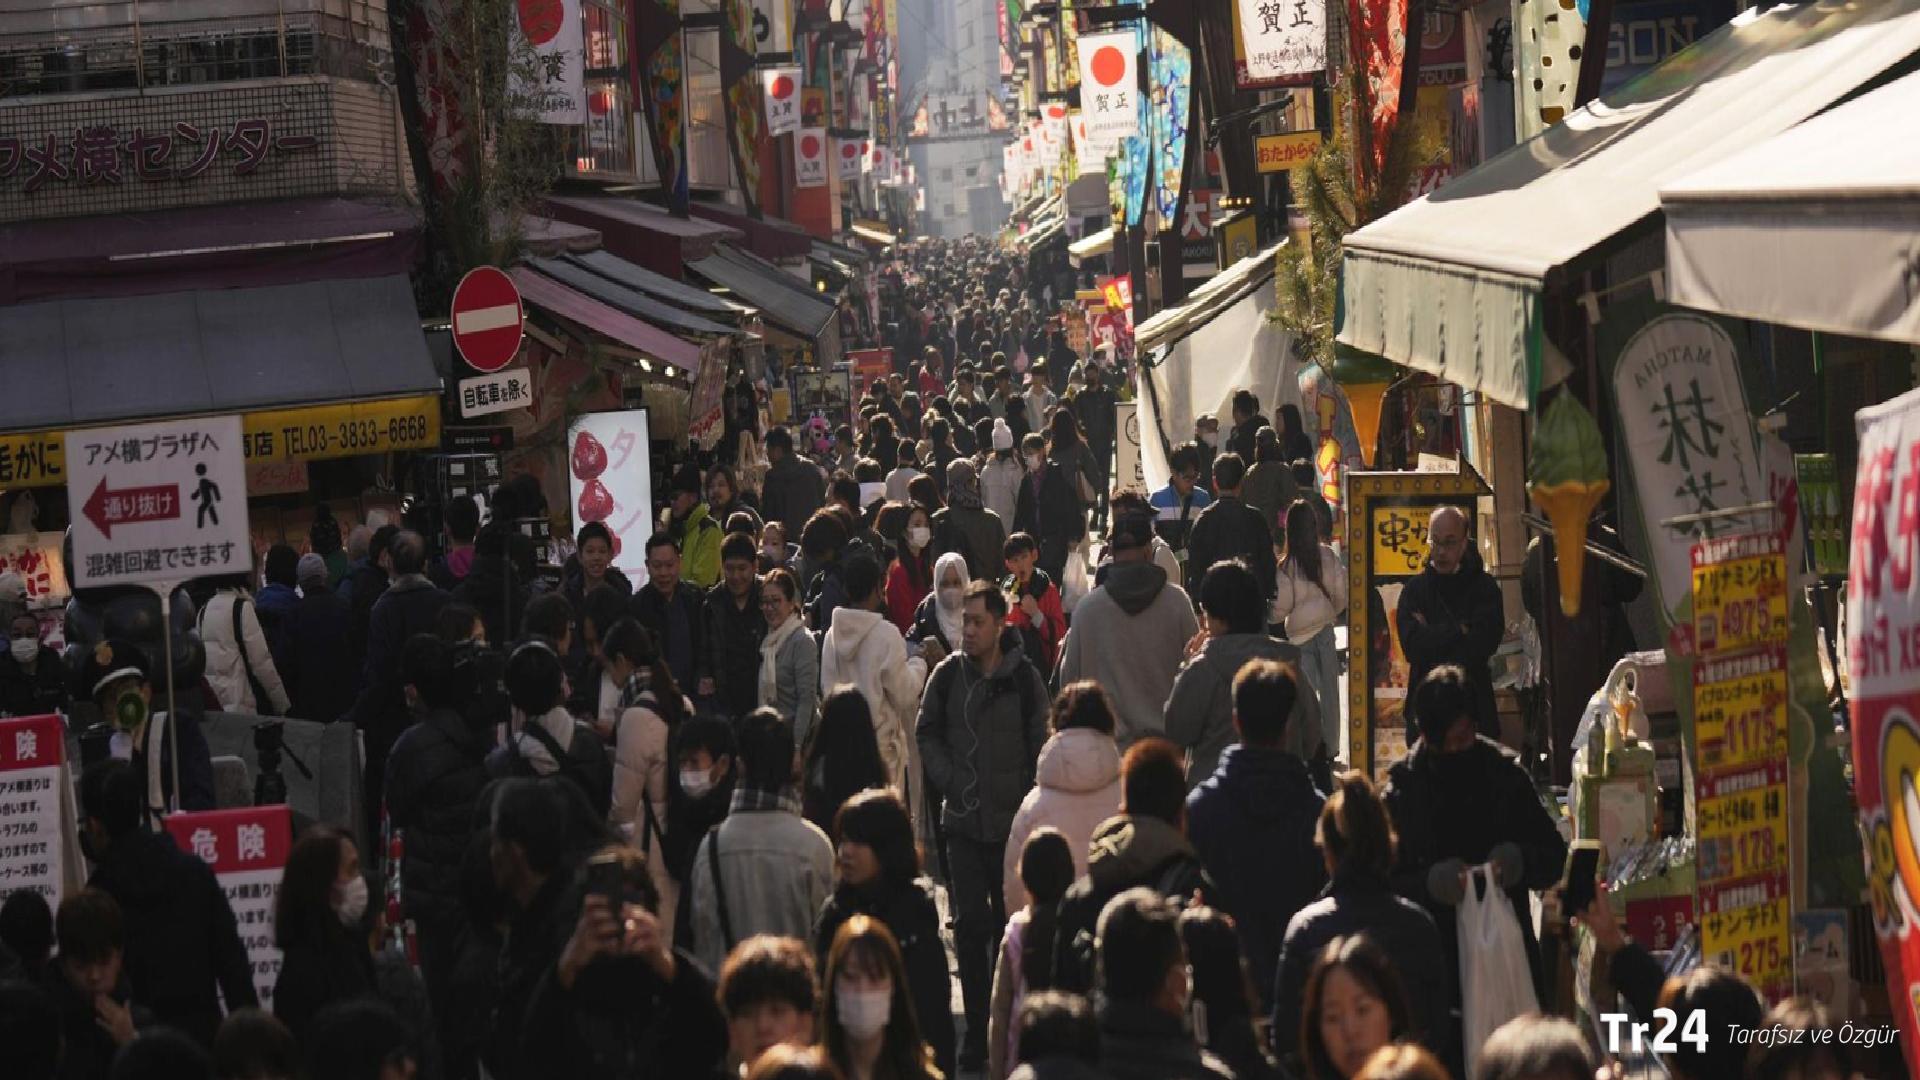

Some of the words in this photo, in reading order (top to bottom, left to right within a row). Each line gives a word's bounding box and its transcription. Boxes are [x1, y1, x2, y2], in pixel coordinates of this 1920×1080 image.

[1257, 1, 1313, 35] 賀正
[1096, 92, 1129, 112] 賀正
[464, 379, 529, 409] 自転車を除く
[85, 430, 219, 466] アメ横プラザへ
[283, 415, 427, 456] TEL03-3833-6668
[104, 493, 173, 519] 通り抜け
[86, 540, 236, 578] 混雑回避できます
[1740, 937, 1781, 976] 275
